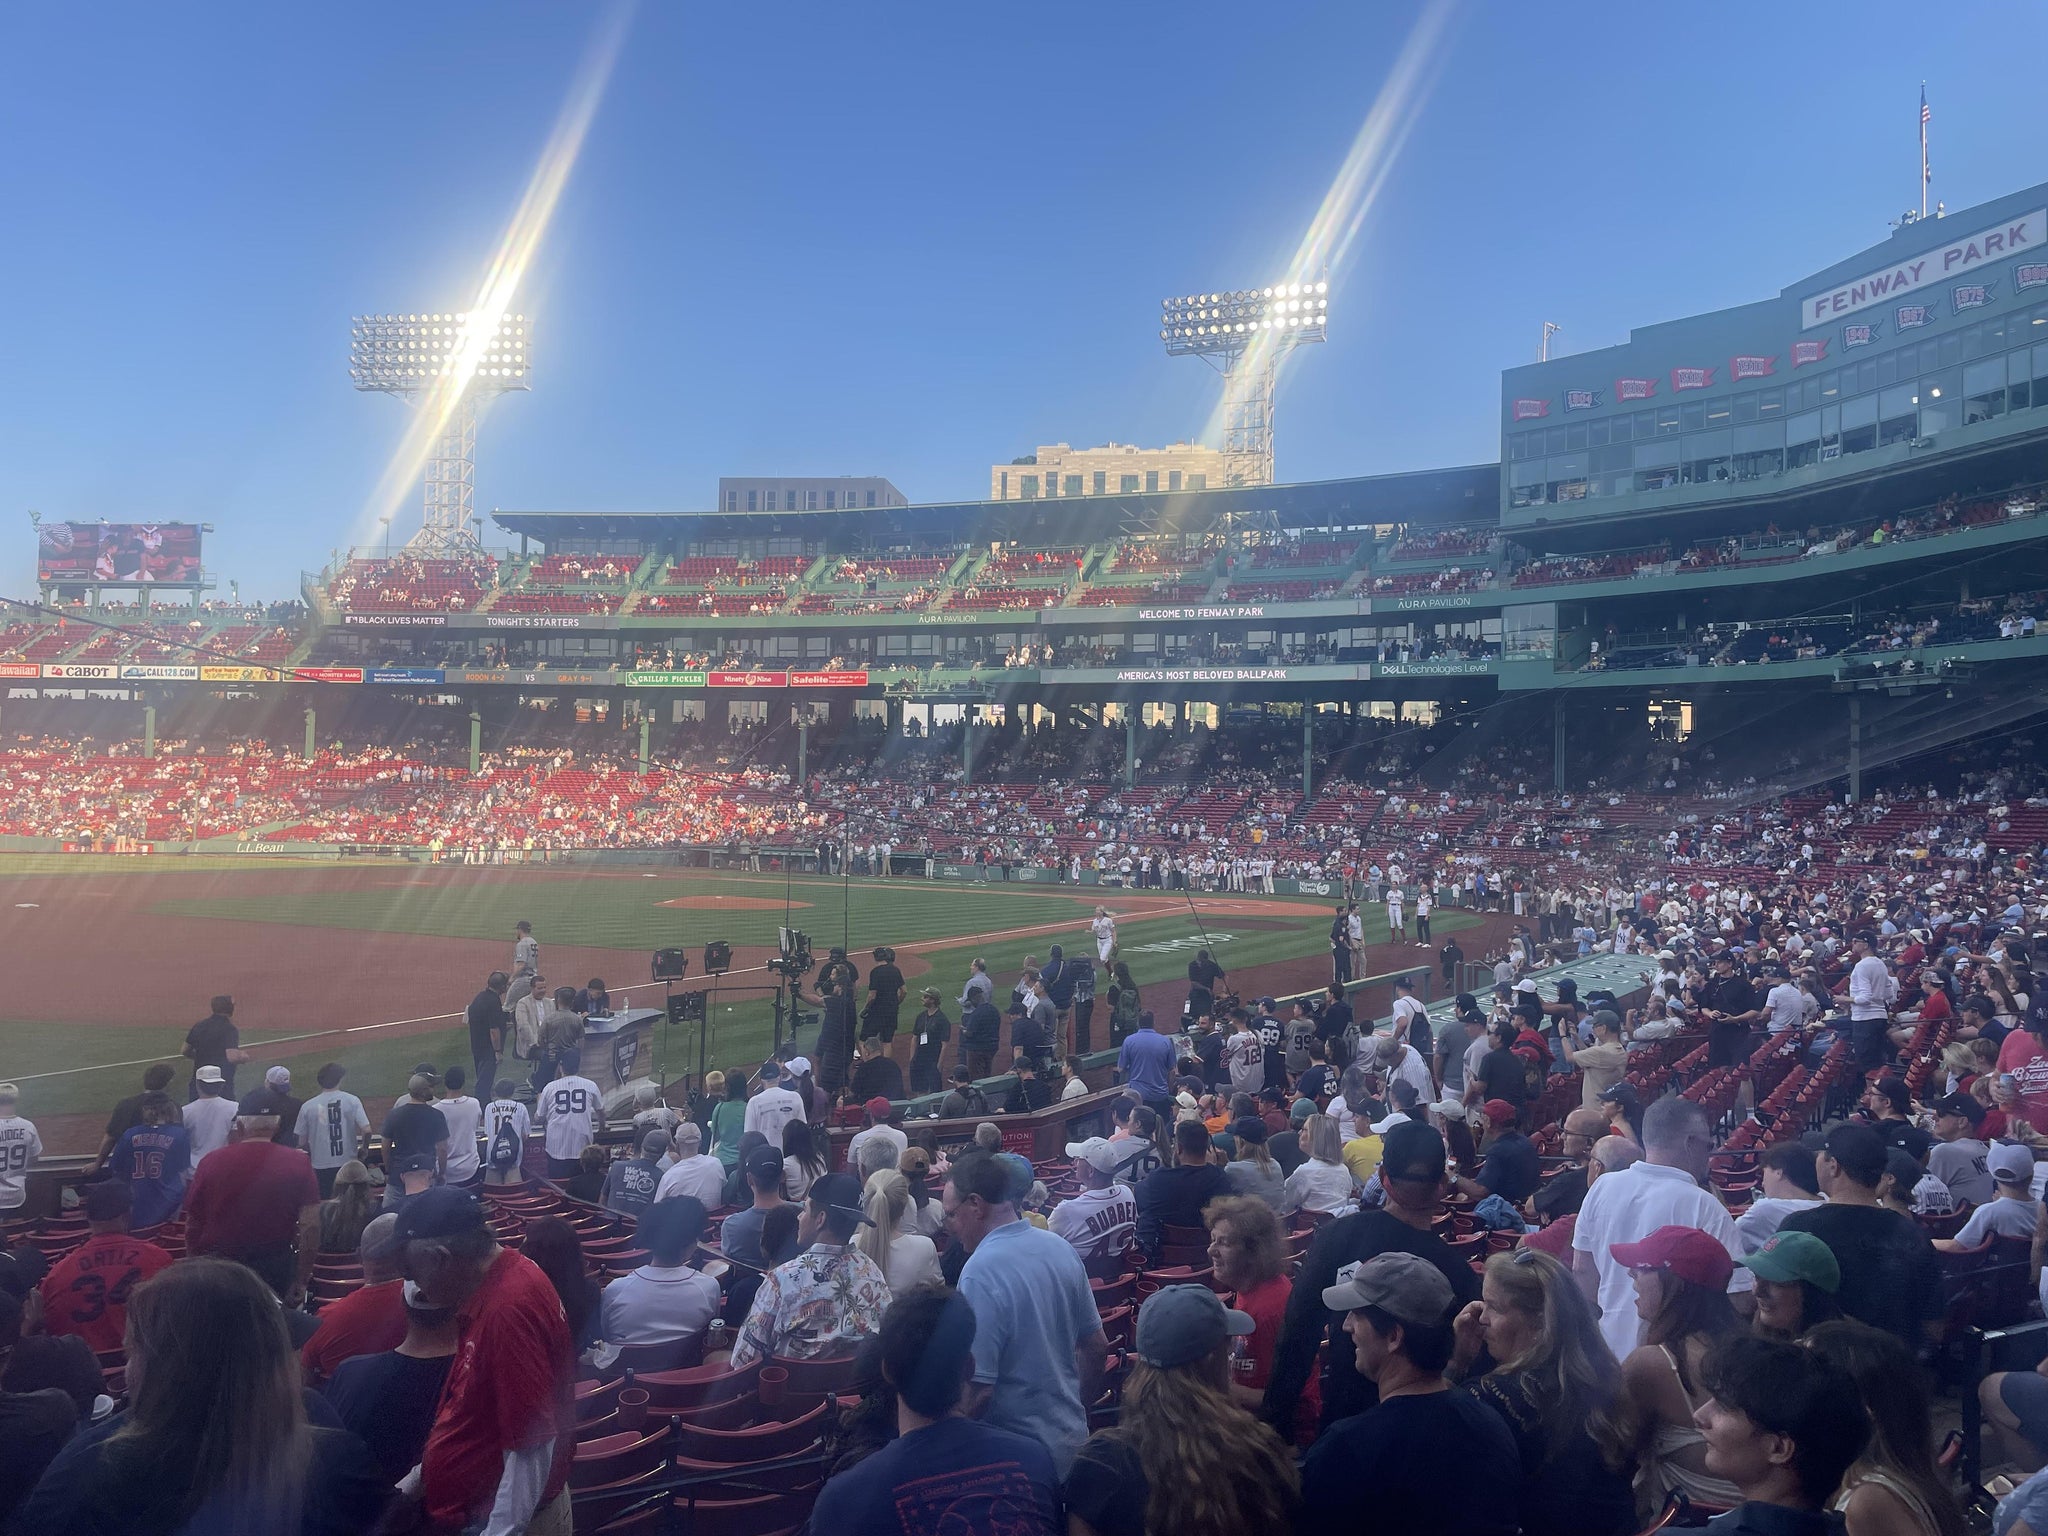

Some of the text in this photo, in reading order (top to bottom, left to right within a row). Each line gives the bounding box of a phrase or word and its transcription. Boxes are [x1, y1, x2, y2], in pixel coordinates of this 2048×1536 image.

[1814, 223, 2028, 319] FENWAY PARK
[1429, 597, 1471, 608] PAVILION
[943, 615, 977, 623] PAVILION
[1139, 607, 1264, 619] WELCOME TO FENWAY PARK
[358, 616, 445, 625] BLACK LIVES MATTER
[486, 617, 580, 627] TONIGHT'S STARTERS
[0, 664, 37, 676] awaiian
[146, 668, 196, 678] CALL128.COM
[1117, 670, 1287, 680] AMERICA'S MOST BELOVED BALLPARK
[1381, 663, 1488, 675] DELL Technologies Level
[525, 674, 535, 682] VS
[637, 675, 702, 683] GRILLO'S PICKLES
[724, 675, 745, 684] Ninety
[792, 676, 829, 684] Safelite
[1294, 1034, 1312, 1051] 99
[554, 1088, 587, 1115] 99
[0, 1128, 26, 1141] UDGE
[131, 1150, 165, 1180] 16
[623, 1173, 640, 1183] got
[625, 1166, 650, 1178] We've
[1926, 1191, 1951, 1208] JUDGE
[78, 1248, 140, 1271] ORTIZ
[70, 1267, 142, 1323] 34
